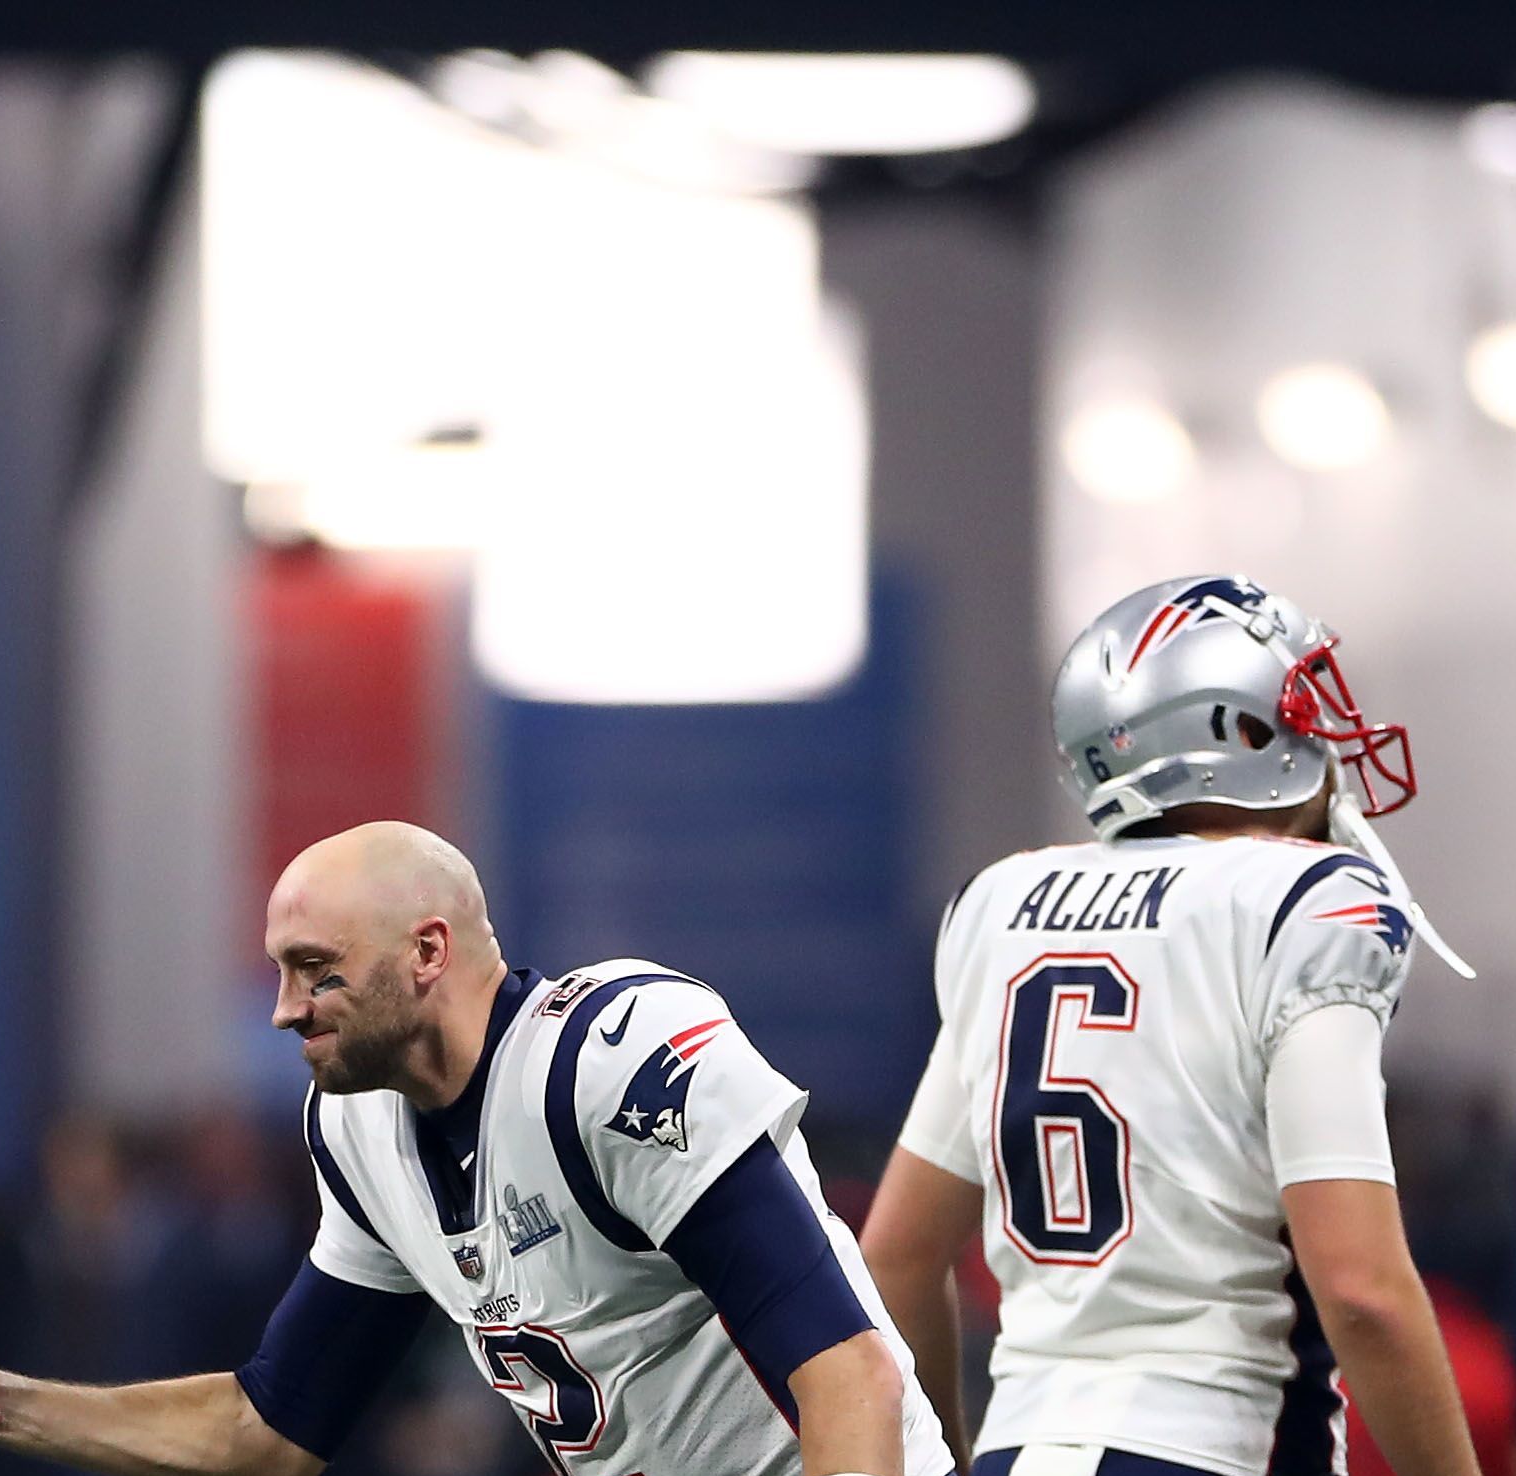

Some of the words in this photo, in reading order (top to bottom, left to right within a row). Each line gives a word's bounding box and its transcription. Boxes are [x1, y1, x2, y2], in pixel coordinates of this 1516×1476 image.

[1085, 746, 1112, 783] 6
[1007, 866, 1186, 932] ALLEN
[991, 951, 1140, 1267] 6
